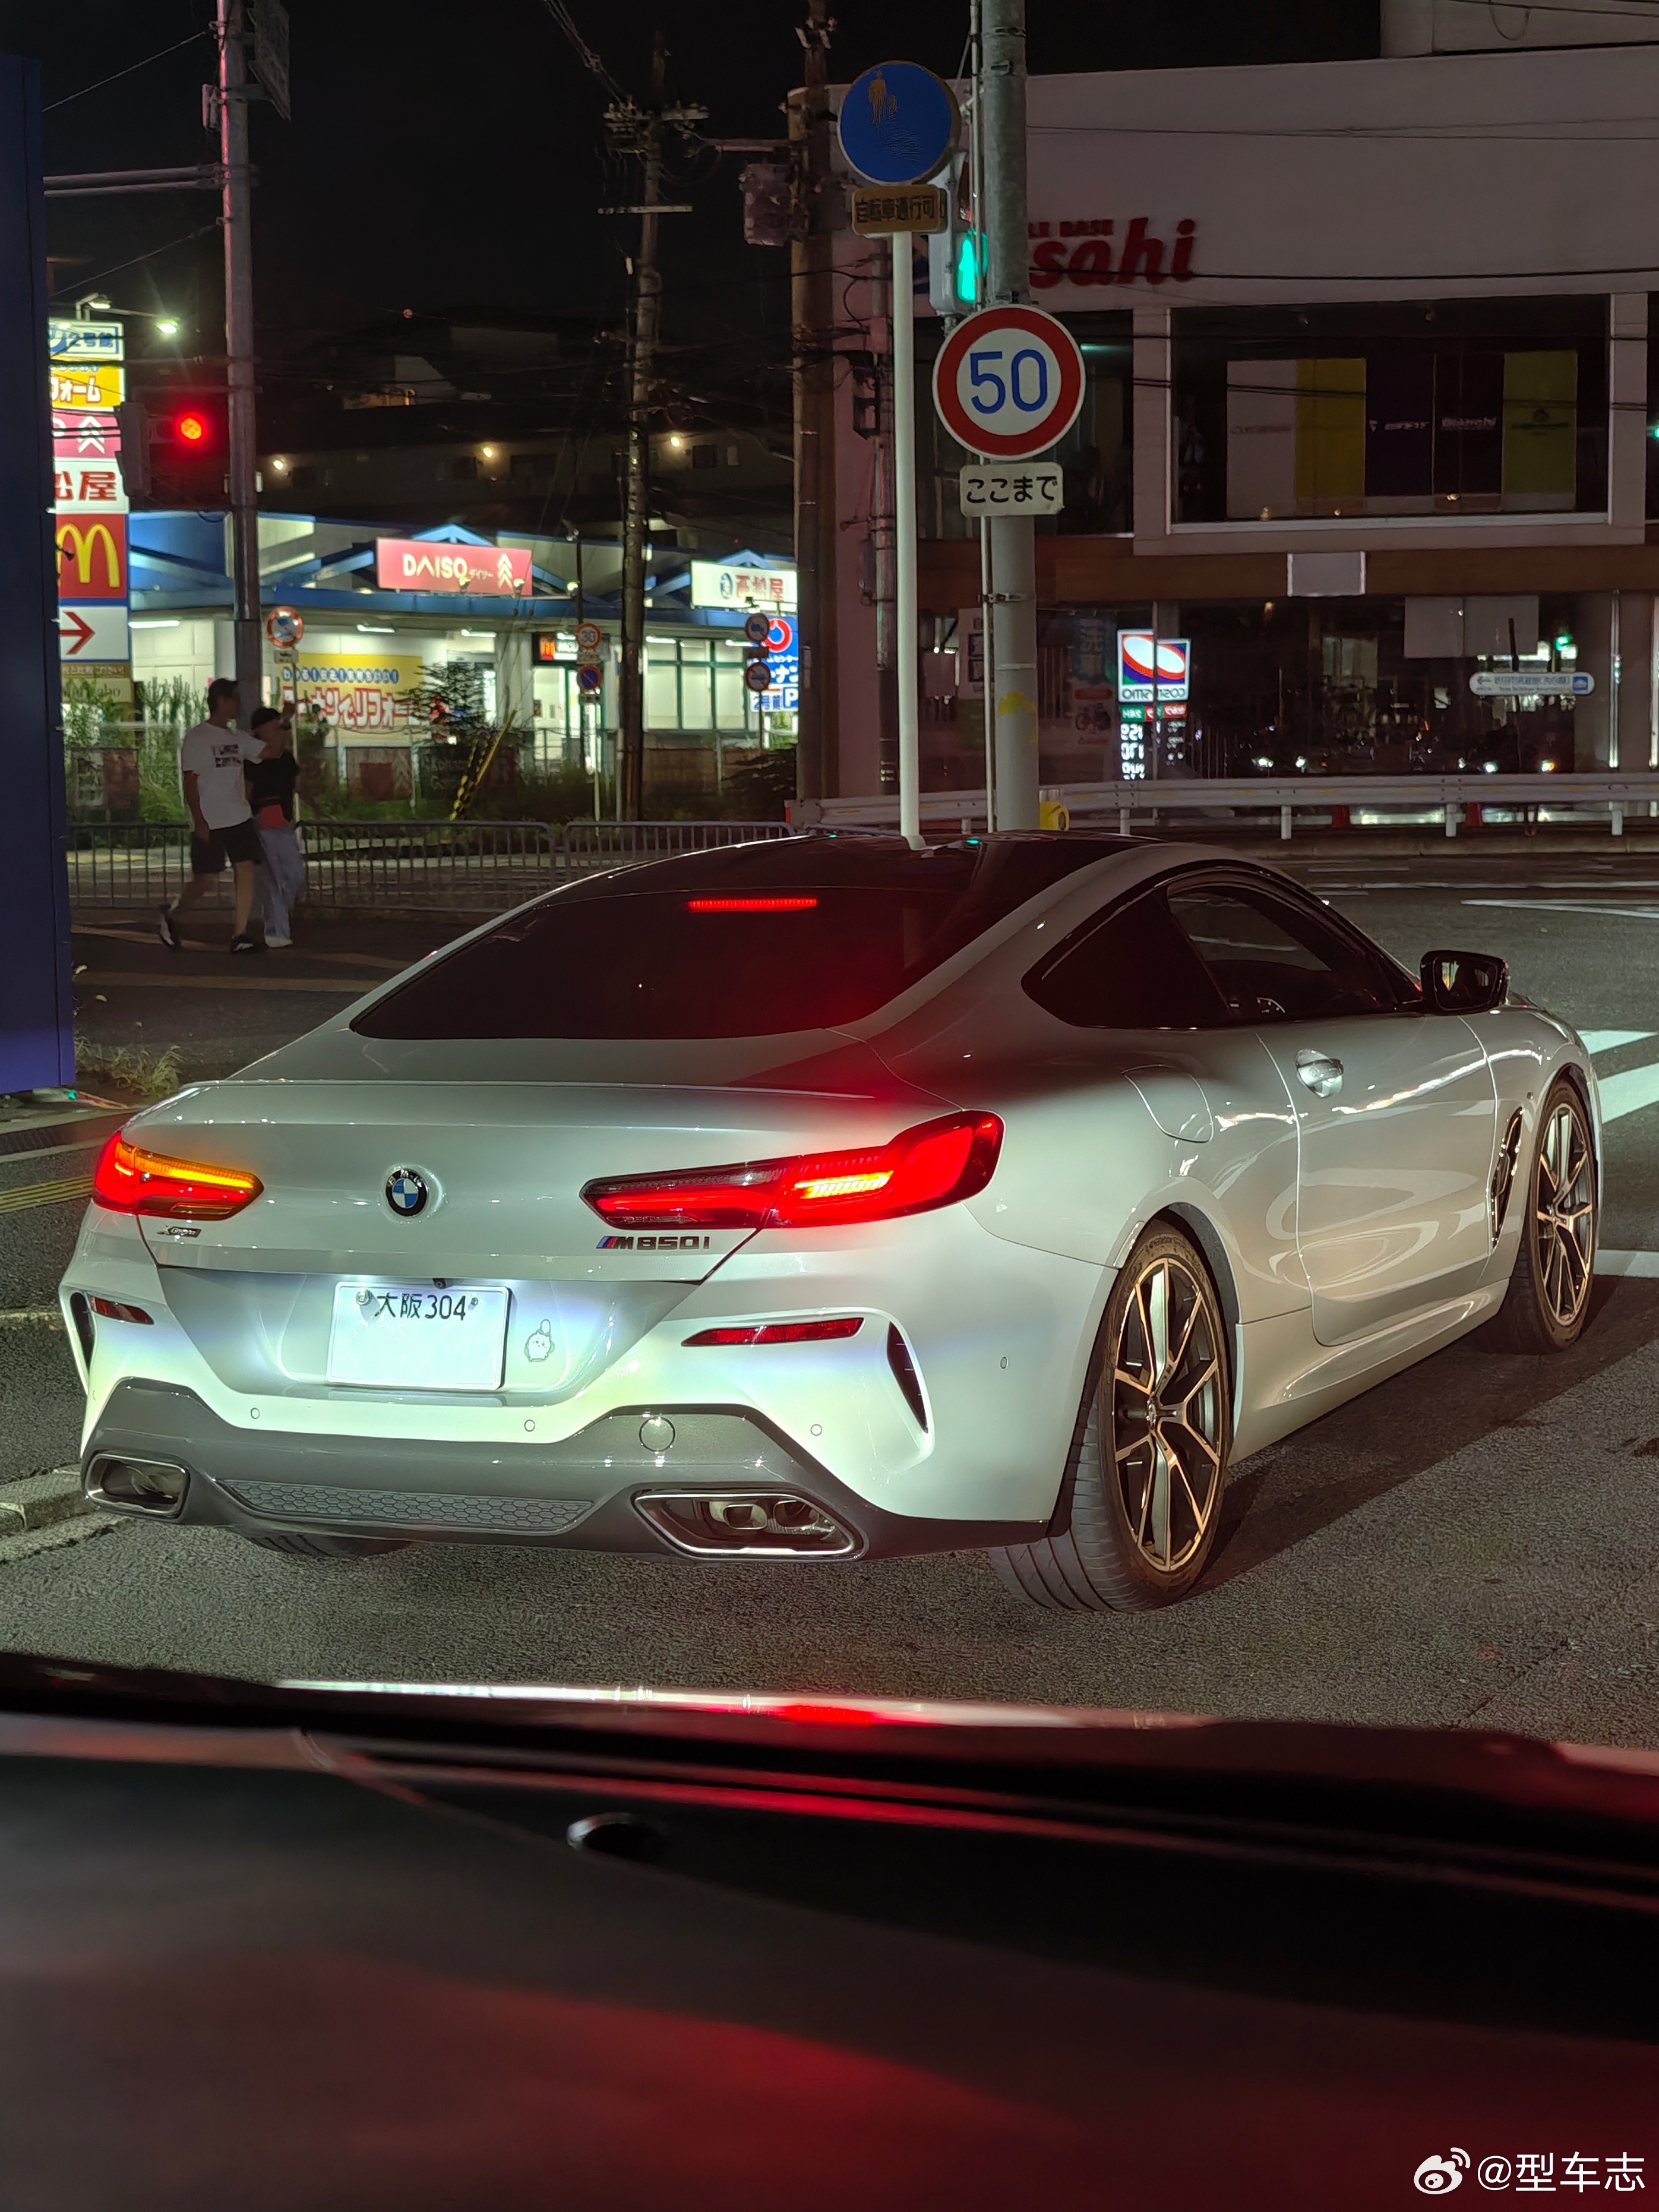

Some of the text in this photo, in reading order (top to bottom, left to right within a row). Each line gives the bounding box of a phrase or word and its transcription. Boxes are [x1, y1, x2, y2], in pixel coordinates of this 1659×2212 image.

[1029, 217, 1195, 289] sahi
[969, 349, 1048, 415] 50
[966, 476, 1058, 504] ここまで
[403, 554, 468, 580] DAISO
